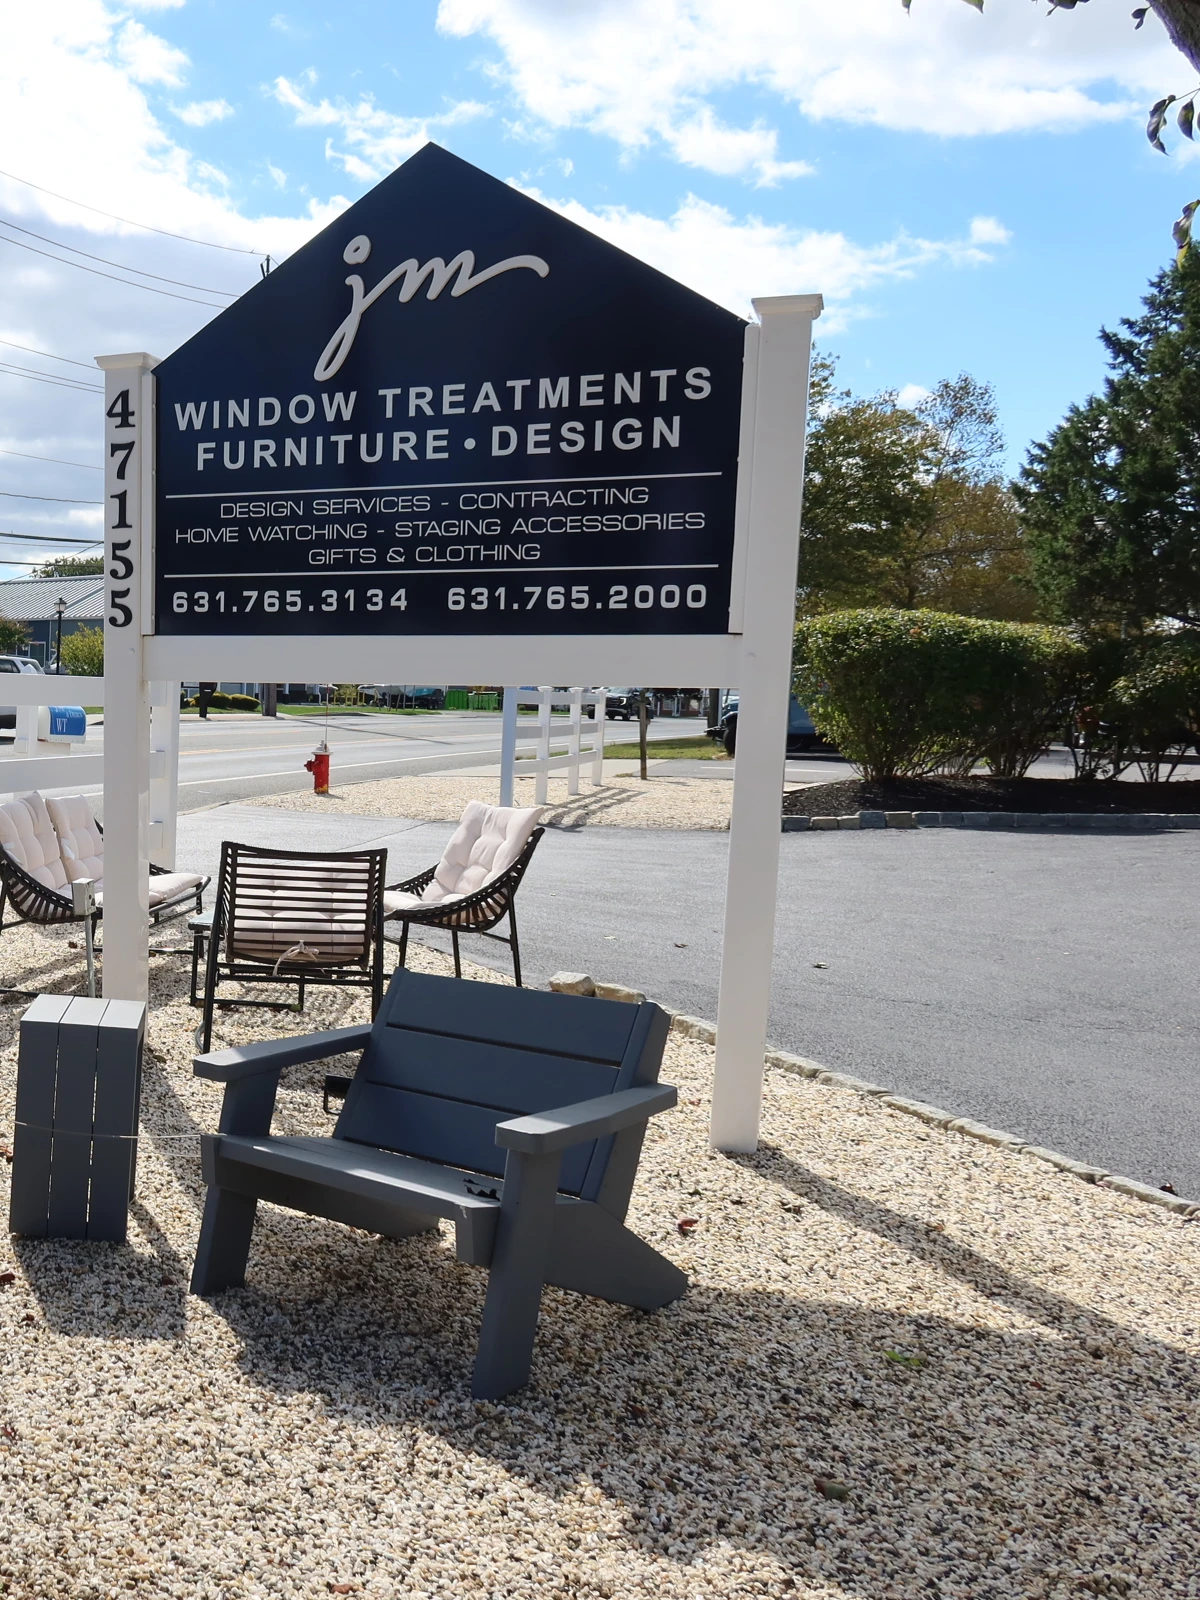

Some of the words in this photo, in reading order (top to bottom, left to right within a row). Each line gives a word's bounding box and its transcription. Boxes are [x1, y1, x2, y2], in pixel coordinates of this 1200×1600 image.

[174, 391, 358, 431] WINDOW
[378, 366, 712, 419] TREATMENTS
[197, 428, 449, 471] FURNITURE
[491, 415, 681, 457] DESIGN
[105, 388, 136, 628] 47155
[220, 500, 304, 519] DESIGN
[312, 495, 431, 515] SERVICES
[459, 486, 649, 510] CONTRACTING
[175, 527, 239, 544] HOME
[247, 523, 368, 542] WATCHING
[395, 517, 501, 538] STAGING
[510, 512, 706, 535] ACCESSORIES
[308, 548, 377, 565] GIFTS
[386, 547, 406, 563] &
[415, 543, 541, 562] CLOTHING
[172, 588, 408, 613] 631.765.3134
[447, 584, 707, 611] 631.765.2000
